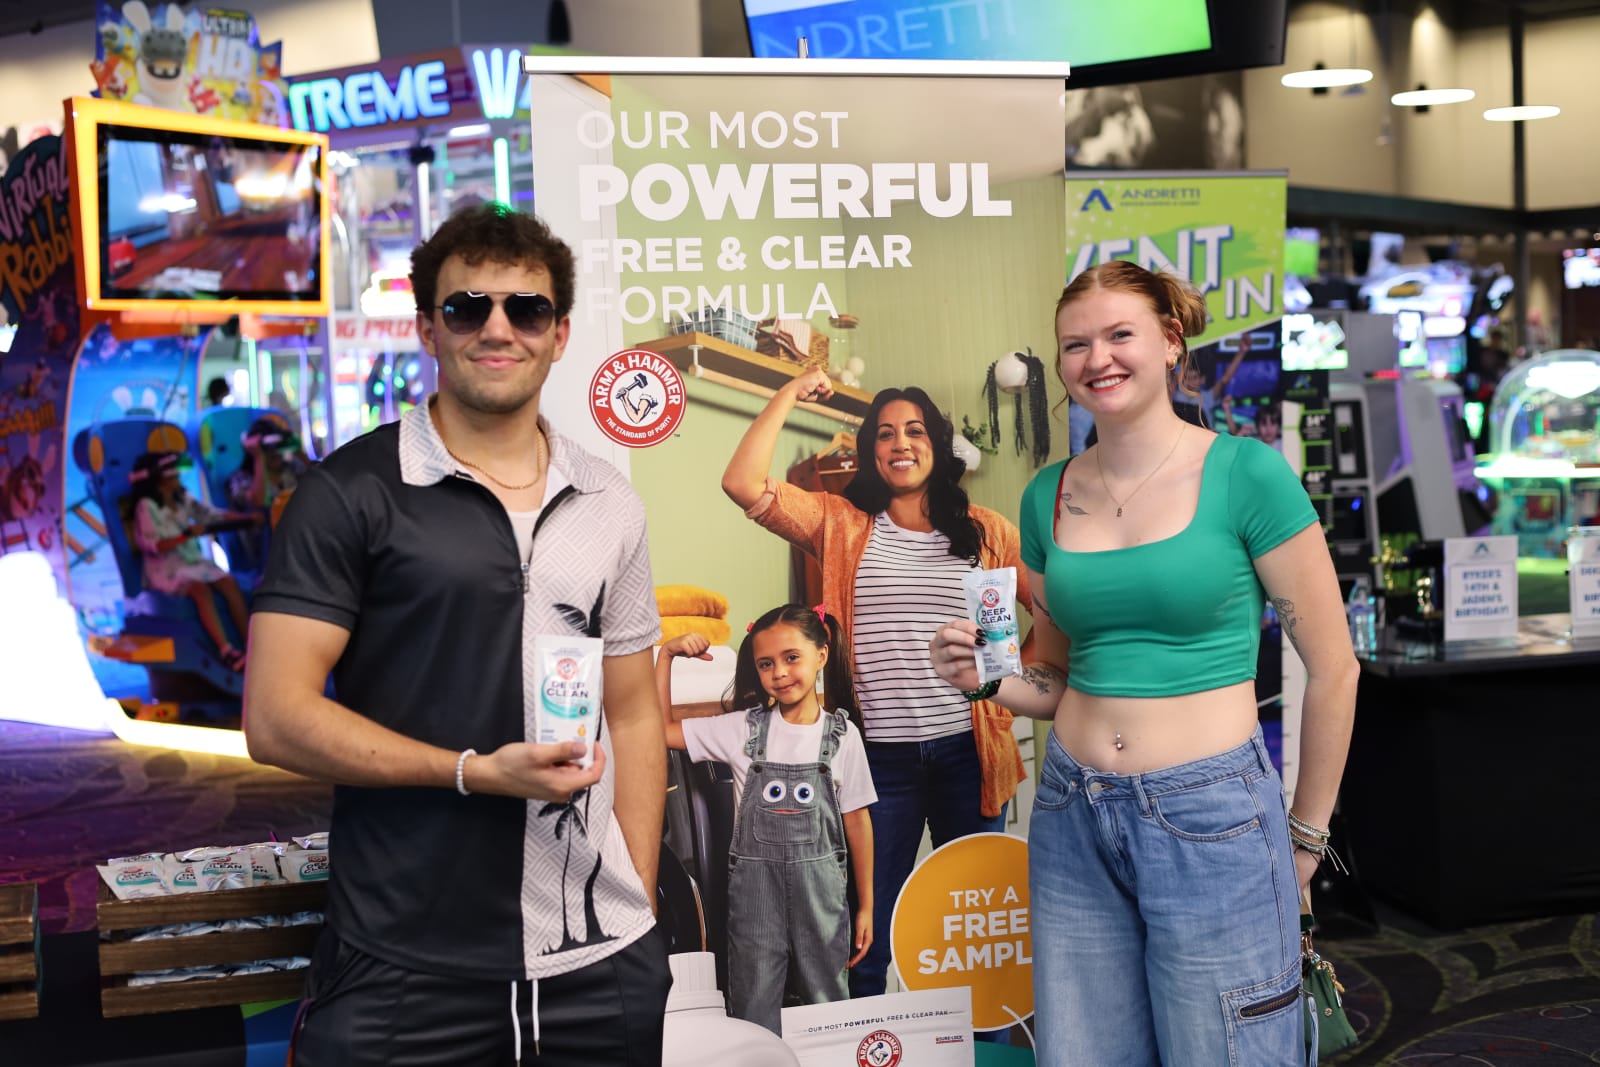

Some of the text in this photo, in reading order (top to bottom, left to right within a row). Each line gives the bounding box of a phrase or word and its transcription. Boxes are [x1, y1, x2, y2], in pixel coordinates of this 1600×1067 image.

[577, 111, 848, 150] OUR MOST
[579, 163, 1012, 221] POWERFUL
[1121, 188, 1200, 199] ANDRETTI
[583, 235, 912, 273] FREE & CLEAR
[585, 283, 838, 325] FORMULA
[1226, 273, 1273, 319] IN
[595, 354, 680, 408] ARM & HAMMER
[606, 417, 616, 429] THE
[616, 426, 647, 439] STANDARD
[656, 416, 672, 434] PURITY
[981, 614, 1011, 624] CLEAN
[982, 608, 1006, 616] DEEP
[546, 688, 588, 698] CLEAN
[950, 886, 1019, 908] TRY A
[944, 908, 1029, 940] FREE
[918, 940, 1032, 974] SAMPL
[844, 1018, 884, 1028] POWERFUL
[860, 1033, 899, 1060] ARM & HAMMER
